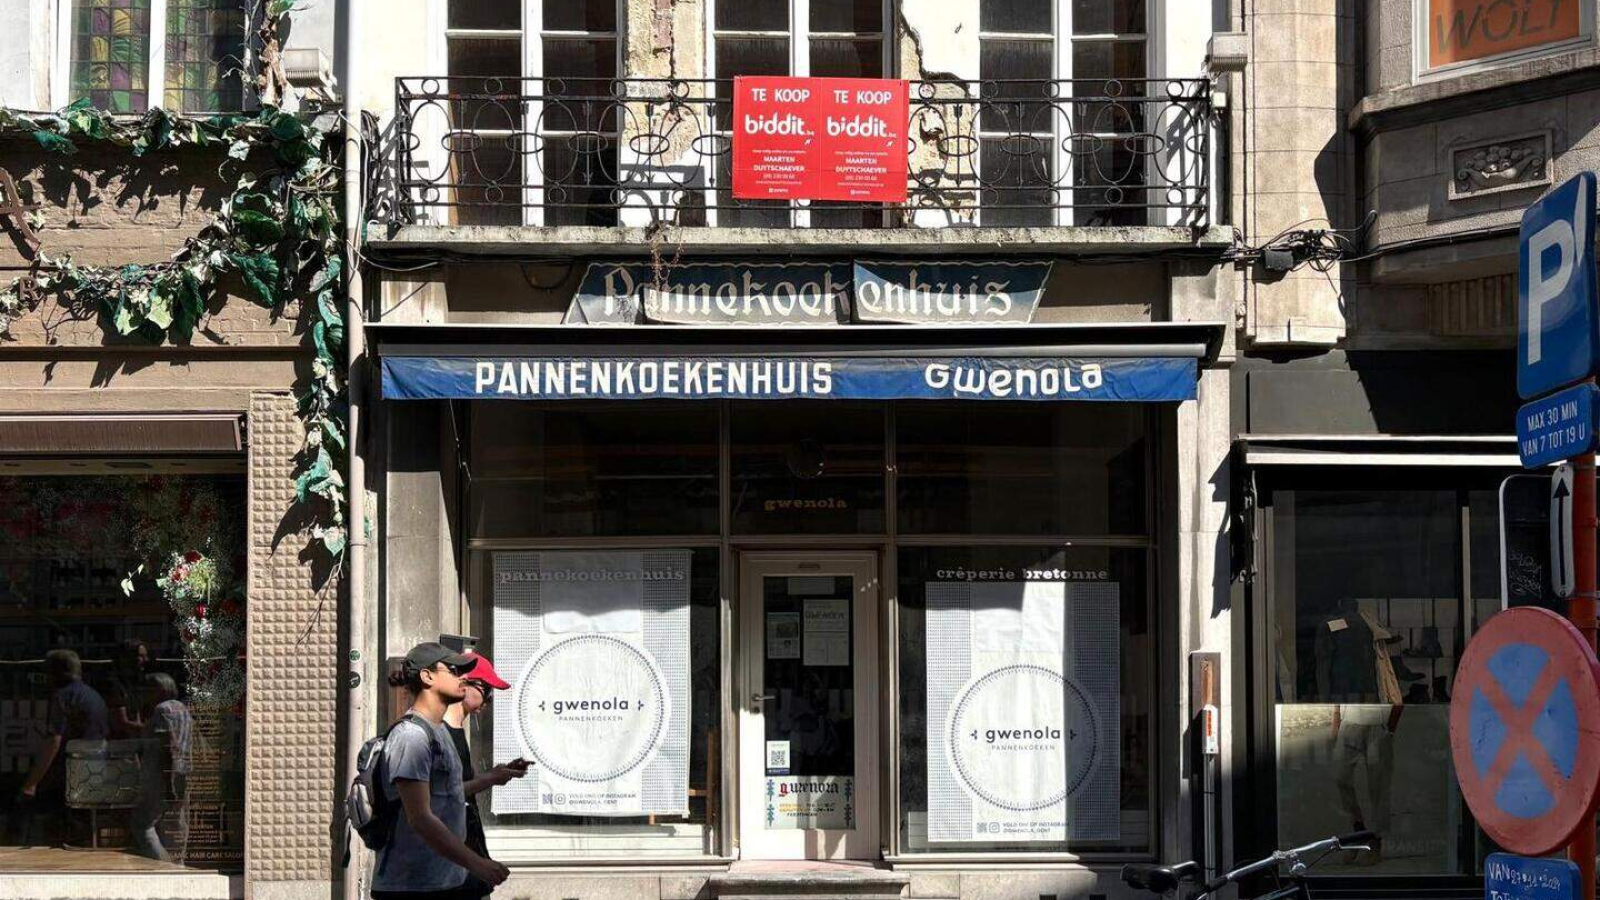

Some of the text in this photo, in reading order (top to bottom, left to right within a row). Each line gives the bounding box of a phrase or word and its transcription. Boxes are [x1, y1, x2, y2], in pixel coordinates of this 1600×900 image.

[751, 88, 810, 103] TE KOOP
[833, 90, 892, 104] TE KOOP
[846, 157, 877, 165] MAARTEN
[603, 267, 1013, 317] Pannekoekenhuis
[1528, 219, 1574, 365] P
[475, 361, 833, 394] PANNENKOEKENHUIS
[1527, 400, 1578, 432] MAX 30 MIN
[1522, 422, 1585, 457] VAN 7 TOT 19 U
[763, 497, 848, 511] gwenola
[499, 567, 685, 583] pannekoekenhuis
[937, 567, 1109, 581] crêperie bretonne
[553, 697, 629, 715] gwenola
[986, 726, 1061, 743] gwenola
[1488, 861, 1510, 881] VAN
